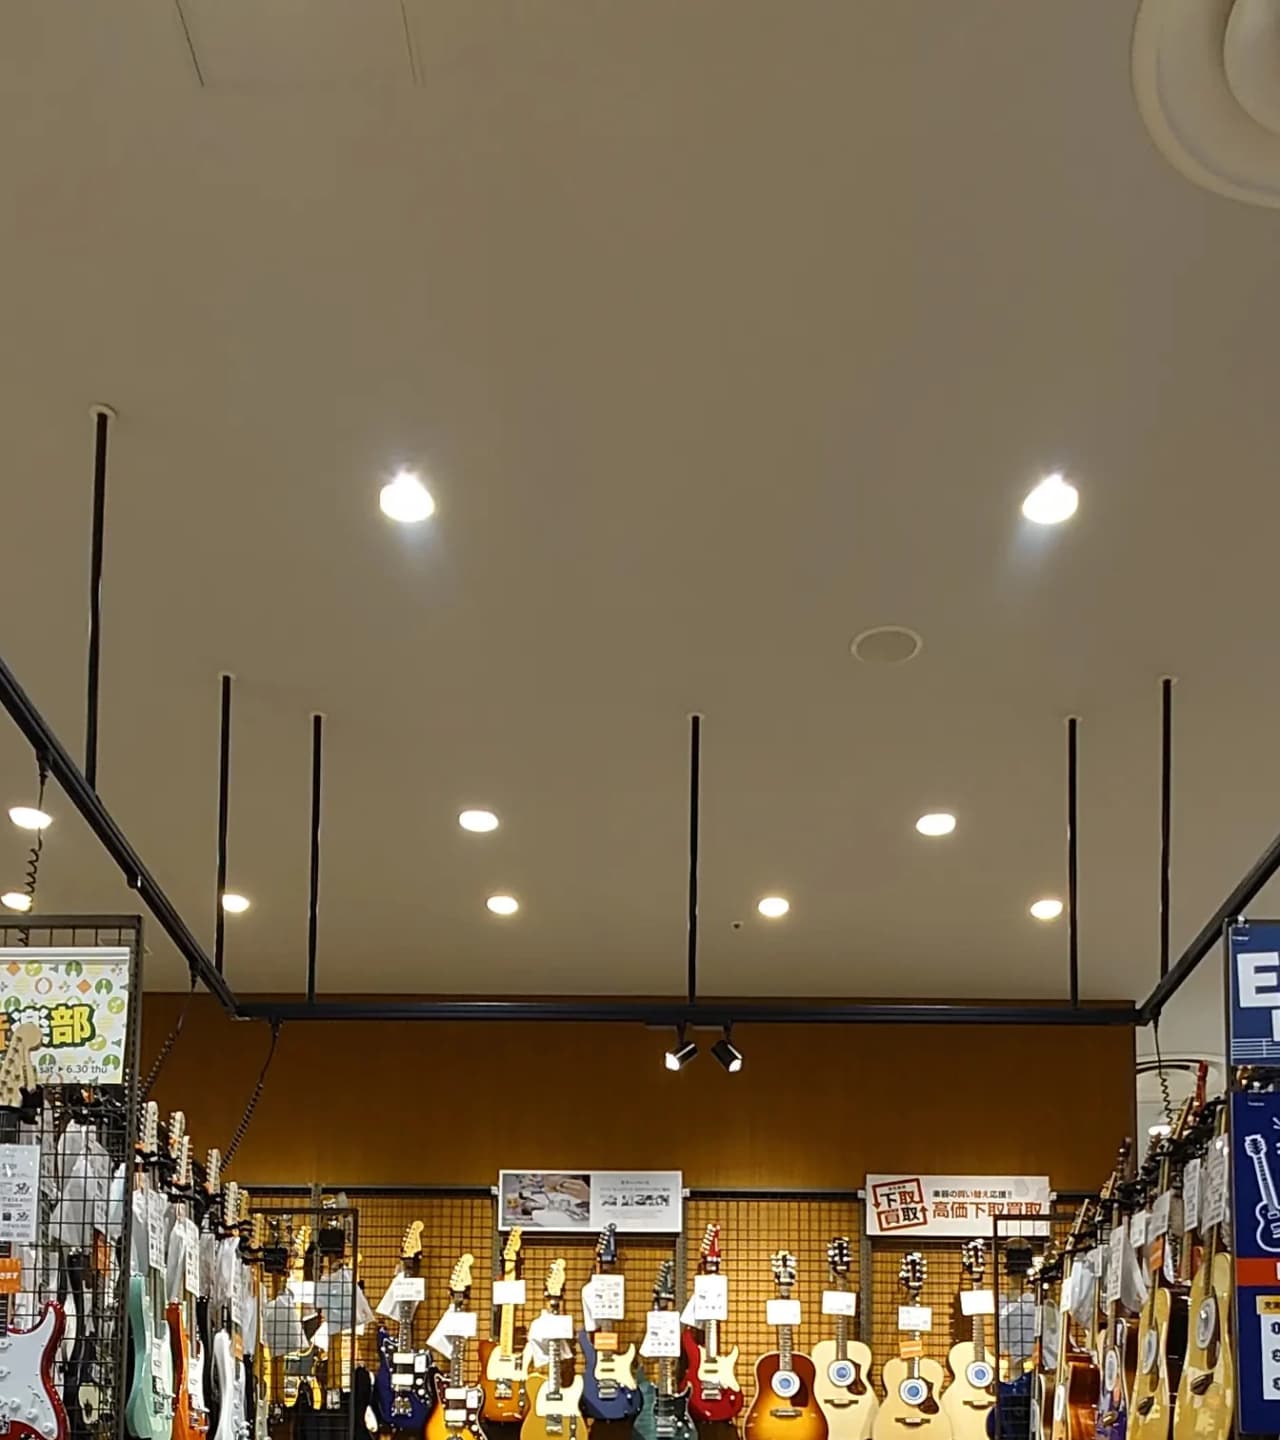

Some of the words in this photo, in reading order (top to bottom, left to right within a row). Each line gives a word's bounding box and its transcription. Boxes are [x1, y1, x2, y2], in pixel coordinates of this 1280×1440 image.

[90, 1065, 109, 1075] thu
[880, 1190, 920, 1209] 下取
[932, 1201, 1042, 1219] 高価下取買取
